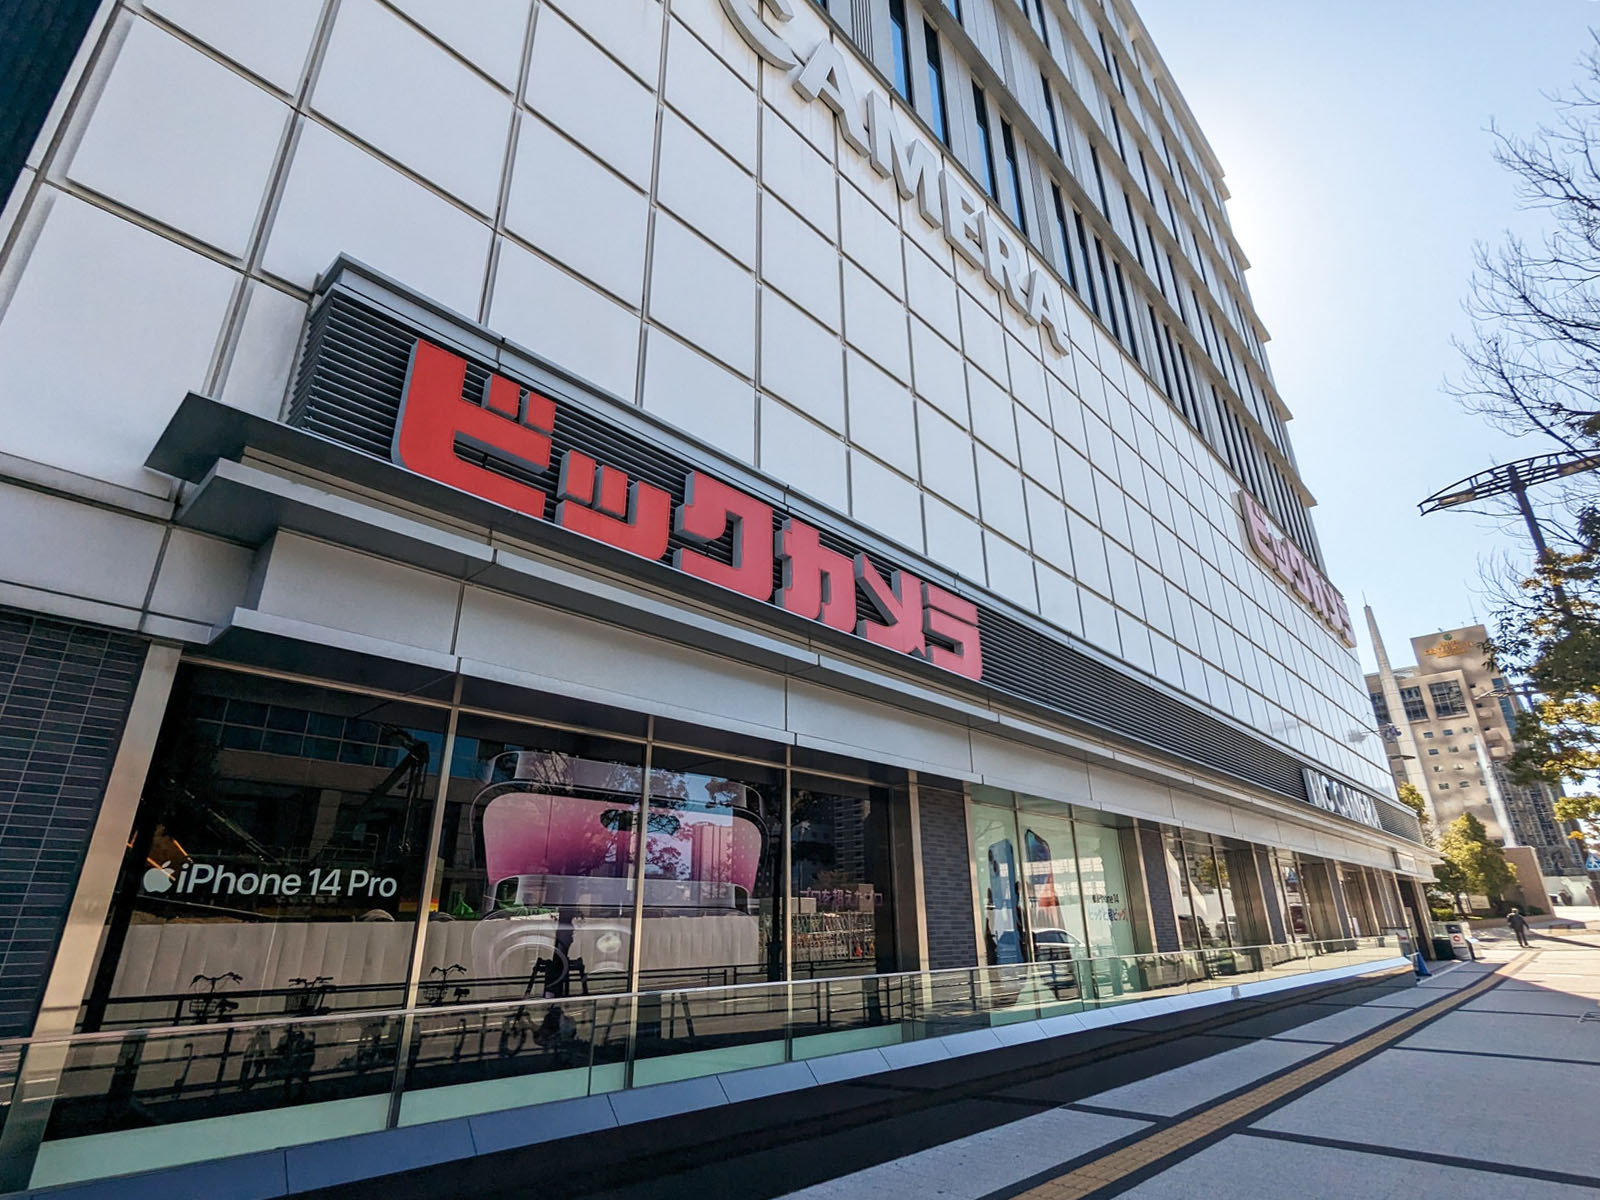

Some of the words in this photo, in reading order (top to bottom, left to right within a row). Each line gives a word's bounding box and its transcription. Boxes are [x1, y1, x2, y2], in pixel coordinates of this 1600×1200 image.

[391, 338, 984, 682] ビックカメラ
[176, 862, 301, 896] iPhone
[309, 868, 341, 897] 14
[347, 869, 398, 898] Pro
